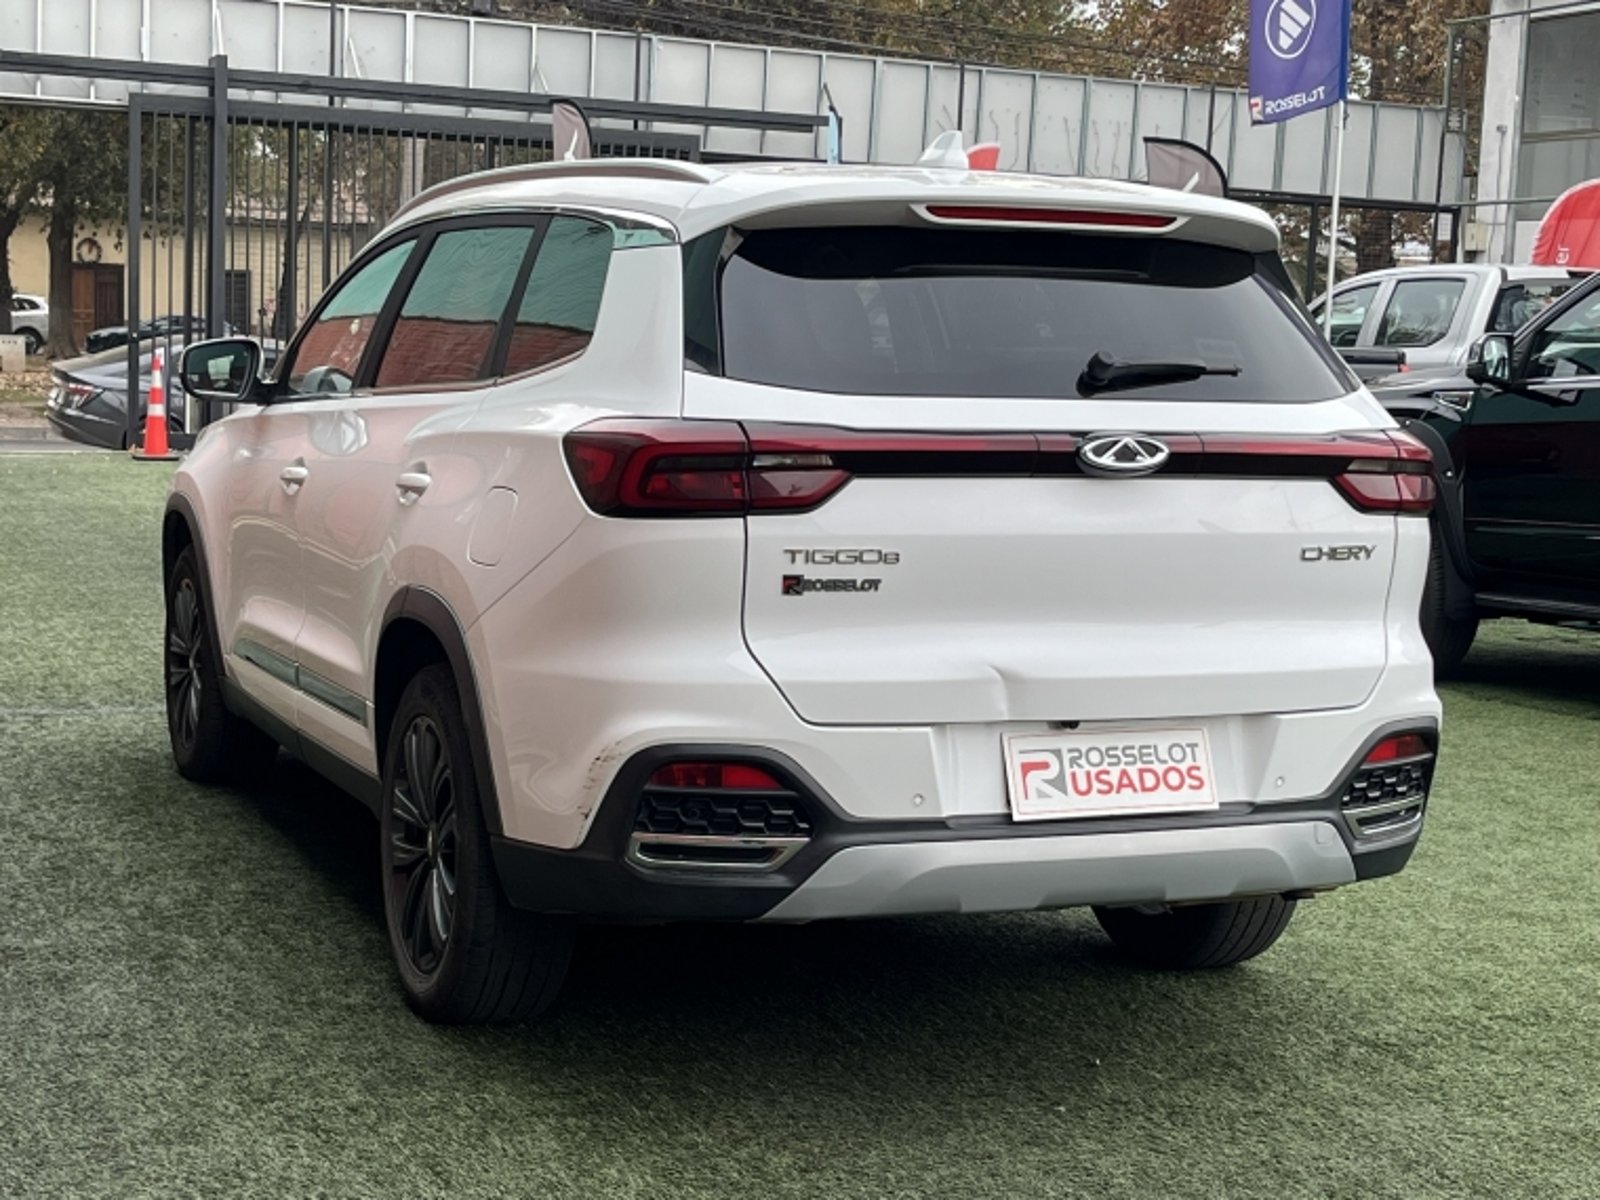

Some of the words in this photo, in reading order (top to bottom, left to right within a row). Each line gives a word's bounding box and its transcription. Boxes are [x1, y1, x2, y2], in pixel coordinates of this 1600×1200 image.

[1264, 85, 1325, 115] ROSSELOT
[1300, 544, 1377, 561] CHERY
[803, 578, 882, 592] ROSSELOT
[1067, 742, 1199, 769] ROSSELOT
[1070, 765, 1205, 796] USADOS
